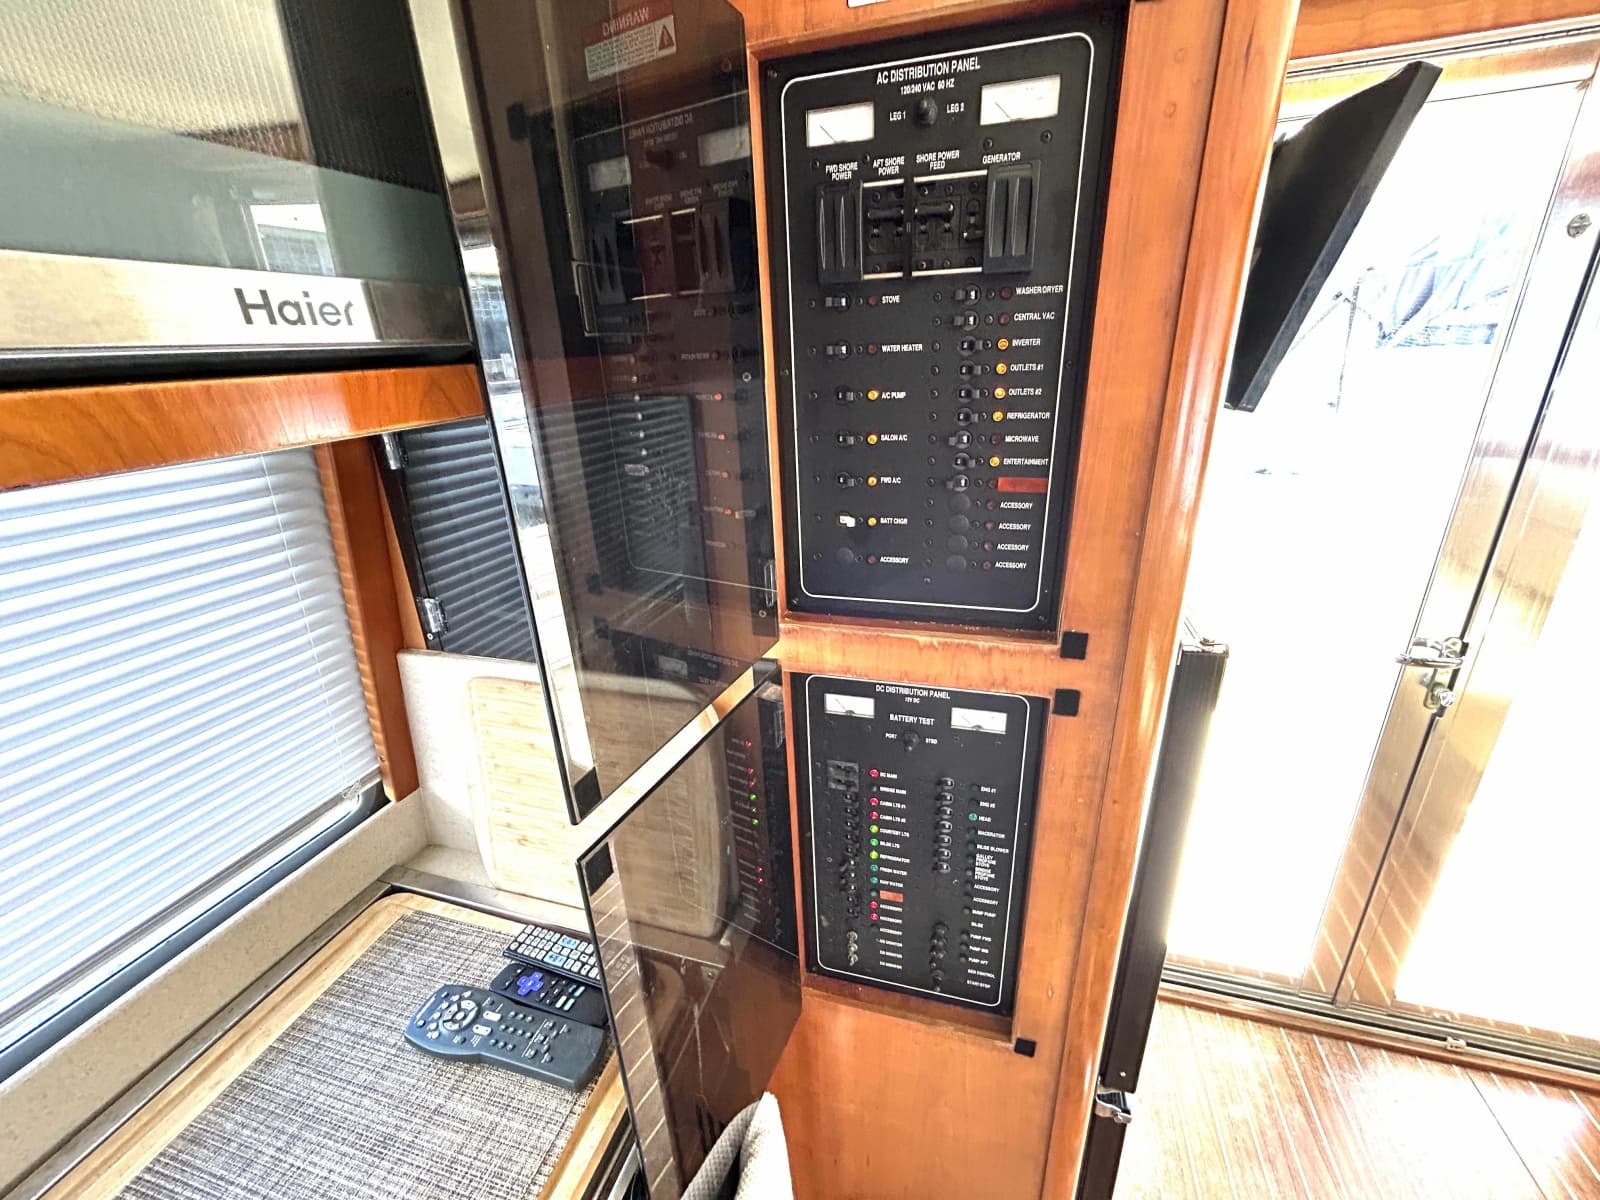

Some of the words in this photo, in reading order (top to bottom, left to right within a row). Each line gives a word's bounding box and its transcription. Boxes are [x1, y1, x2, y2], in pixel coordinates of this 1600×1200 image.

[876, 70, 888, 84] AC
[890, 60, 949, 82] DISTRIBUTION
[950, 56, 980, 75] PANEL
[922, 81, 936, 92] VAC
[946, 79, 954, 89] HZ
[946, 103, 958, 113] LEG
[890, 111, 902, 120] LEG
[902, 111, 906, 120] 1
[916, 154, 936, 162] SHORE
[938, 150, 960, 160] POWER
[982, 152, 1020, 164] GENERATOR
[873, 158, 883, 168] AFT
[884, 156, 904, 166] SHORE
[929, 161, 945, 170] FEED
[826, 165, 838, 173] FWD
[838, 162, 858, 172] SHORE
[878, 166, 899, 175] POWER
[832, 170, 852, 180] POWER
[881, 295, 900, 304] STOVE
[233, 287, 354, 327] Haier
[1014, 313, 1041, 321] CENTRAL
[1042, 312, 1055, 320] VAC
[1012, 338, 1040, 346] INVERTER
[901, 344, 923, 352] HEATER
[1008, 388, 1033, 396] OUTLETS
[1006, 412, 1050, 420] REFRIGERATOR
[1003, 458, 1048, 466] ENTERTAINMENT
[1000, 502, 1033, 510] ACCESSORY
[998, 523, 1032, 531] ACCESSORY
[995, 561, 1027, 569] ACCESSORY
[885, 686, 928, 698] DISTRIBUTION
[929, 690, 950, 699] PANEL
[889, 714, 918, 724] BATTERY
[919, 717, 934, 725] TEST
